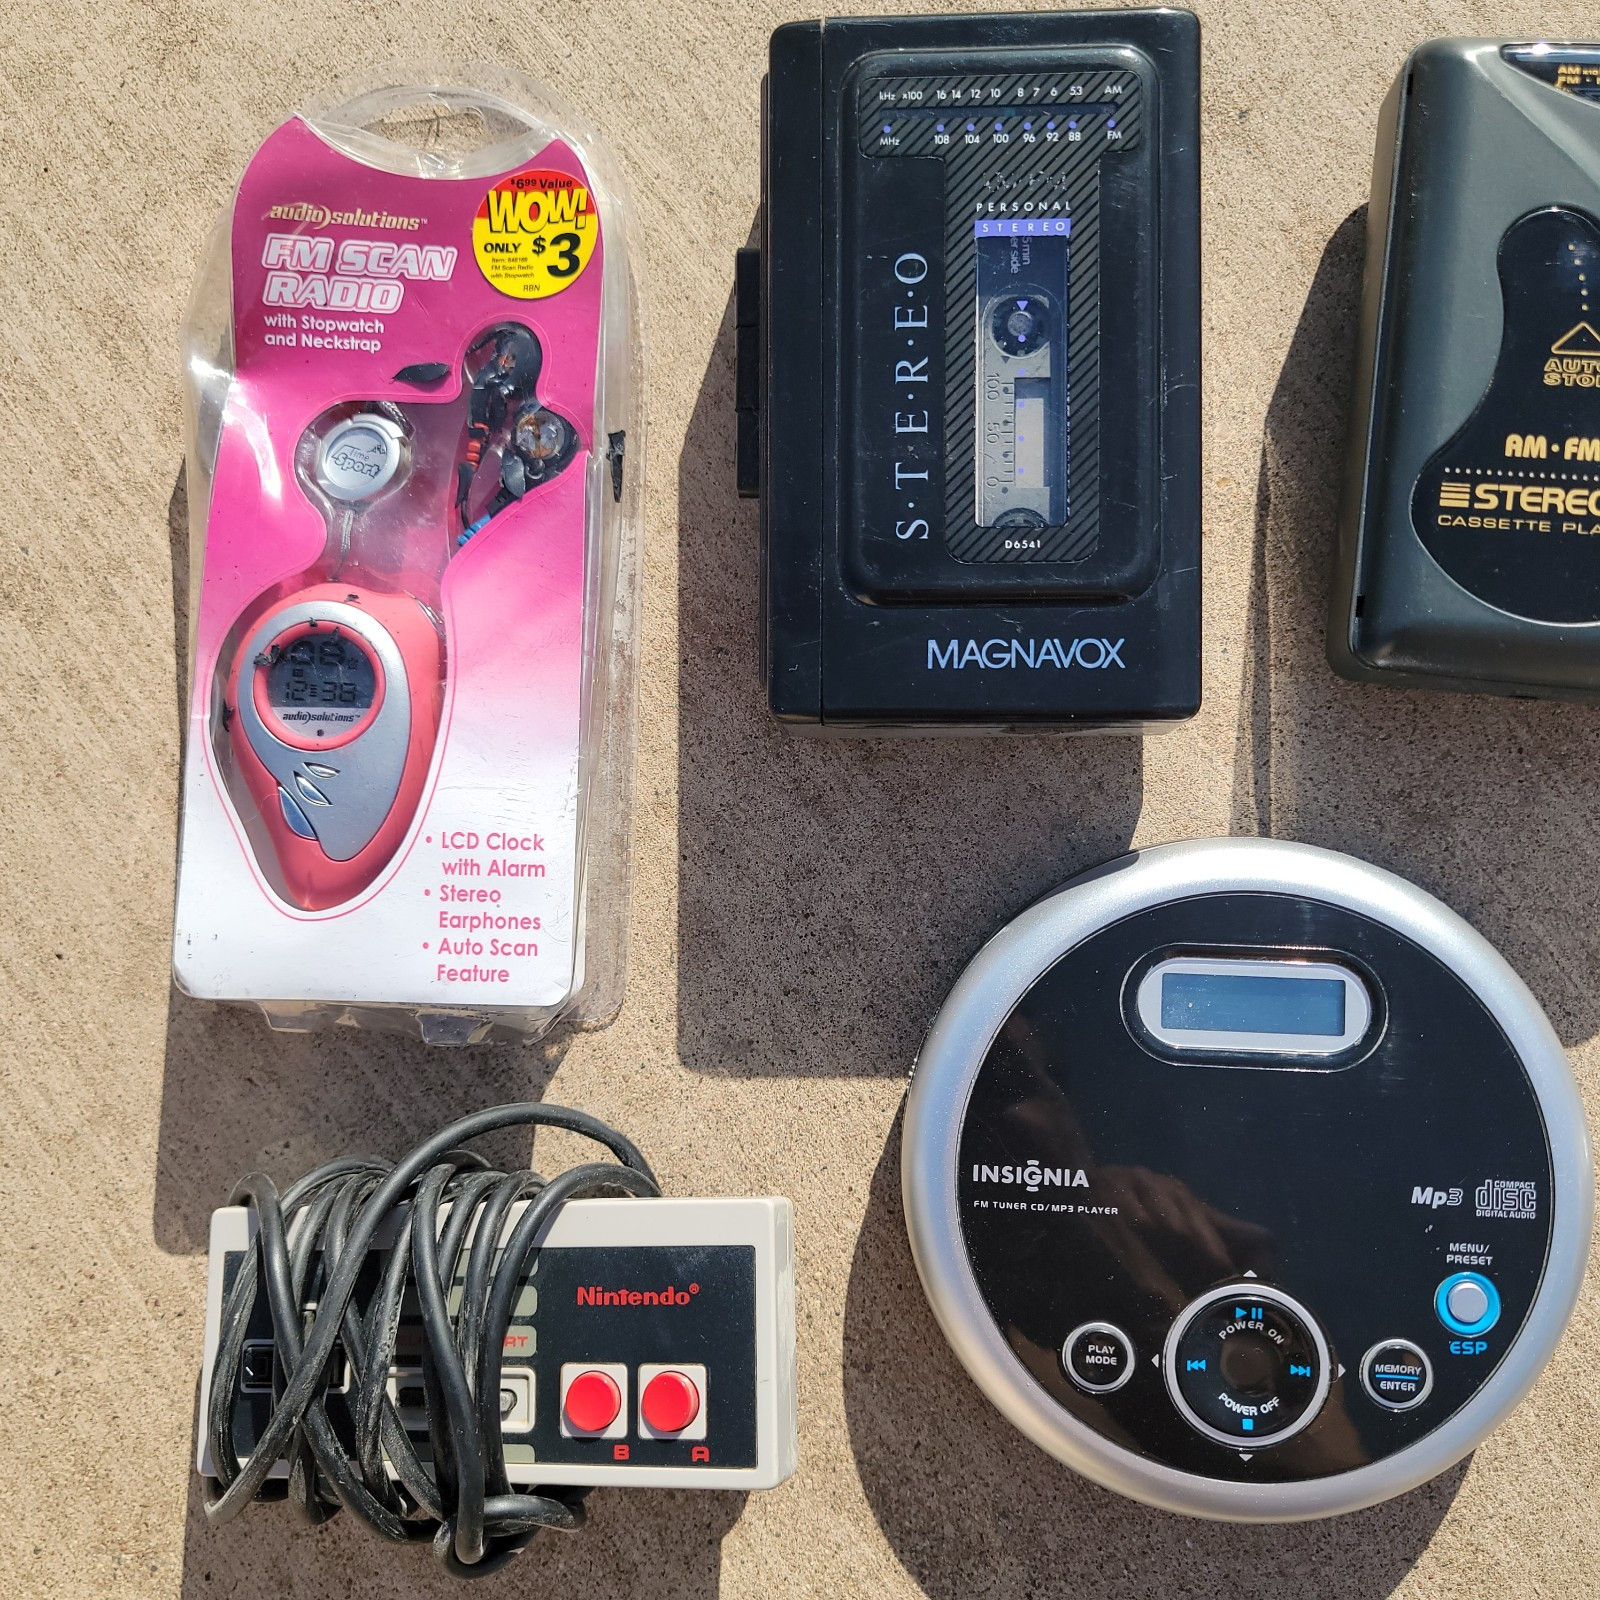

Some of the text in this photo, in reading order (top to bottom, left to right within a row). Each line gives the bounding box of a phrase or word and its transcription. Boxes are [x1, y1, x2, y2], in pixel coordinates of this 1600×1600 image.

[1557, 65, 1581, 75] AM
[879, 91, 897, 100] kHz
[936, 90, 947, 99] 16
[951, 89, 962, 98] 14
[971, 89, 981, 98] 12
[990, 88, 1001, 98] 10
[1017, 87, 1024, 97] 8
[1033, 87, 1040, 97] 7
[1050, 87, 1058, 96] 6
[1104, 85, 1123, 94] AM
[879, 130, 1122, 146] MHz 108 104 100 96 92 88 FM
[540, 178, 573, 189] Value
[487, 188, 588, 234] WOW!
[976, 200, 1071, 212] PERSONAL
[982, 222, 1065, 233] STEREO
[262, 232, 459, 281] FM SCAN
[483, 242, 521, 254] ONLY
[262, 270, 405, 314] RADIO
[523, 284, 541, 292] RBN
[264, 313, 385, 333] with Stopwatch
[264, 333, 382, 353] and Neckstrap
[1437, 513, 1552, 533] CASSETTE
[1004, 539, 1041, 549] D6541
[927, 638, 1126, 670] MAGNAVOX
[441, 831, 545, 851] LCD Clock
[441, 857, 546, 878] with Alarm
[439, 884, 502, 903] Stereo
[438, 910, 541, 933] Earphones
[437, 937, 539, 957] Auto Scan
[436, 963, 510, 983] Feature
[972, 1159, 1090, 1192] INSIGNIA
[1493, 1180, 1536, 1190] COMPACT
[1410, 1186, 1464, 1209] Mp3
[1475, 1179, 1537, 1211] disc
[973, 1200, 1119, 1215] FM TUNER CD/MP3 PLAYER
[1475, 1209, 1536, 1220] DIGITAL AUDIO
[1446, 1254, 1494, 1266] PRESET
[1218, 1320, 1285, 1345] POWER ON
[1088, 1344, 1116, 1354] PLAY
[1449, 1341, 1489, 1355] ESP
[1085, 1354, 1118, 1366] MODE
[1375, 1364, 1422, 1376] MEMORY
[1380, 1381, 1416, 1392] ENTER
[1218, 1392, 1281, 1416] POWER OFF
[613, 1444, 630, 1461] B
[691, 1446, 710, 1463] A
